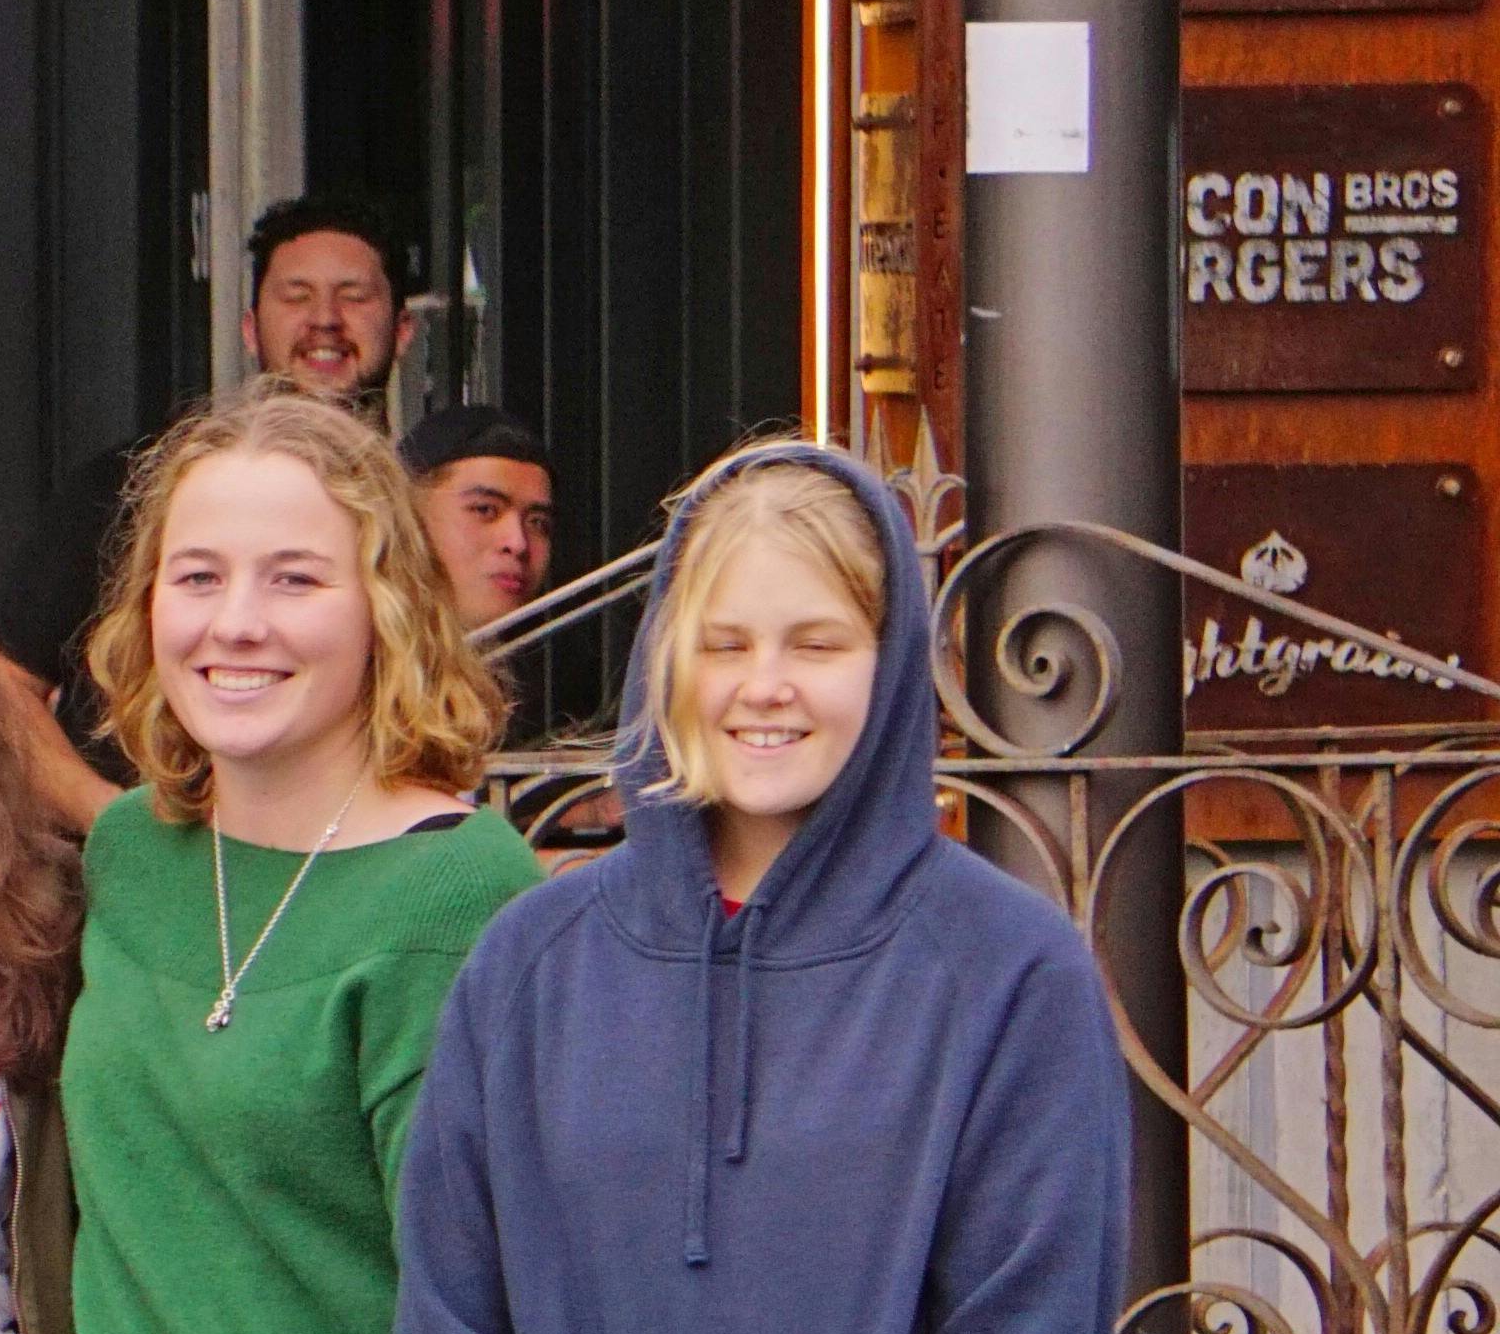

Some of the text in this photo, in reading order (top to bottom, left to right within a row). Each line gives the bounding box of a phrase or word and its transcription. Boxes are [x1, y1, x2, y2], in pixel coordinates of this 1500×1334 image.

[1187, 168, 1459, 238] CON BROS
[1187, 237, 1425, 304] RGERS
